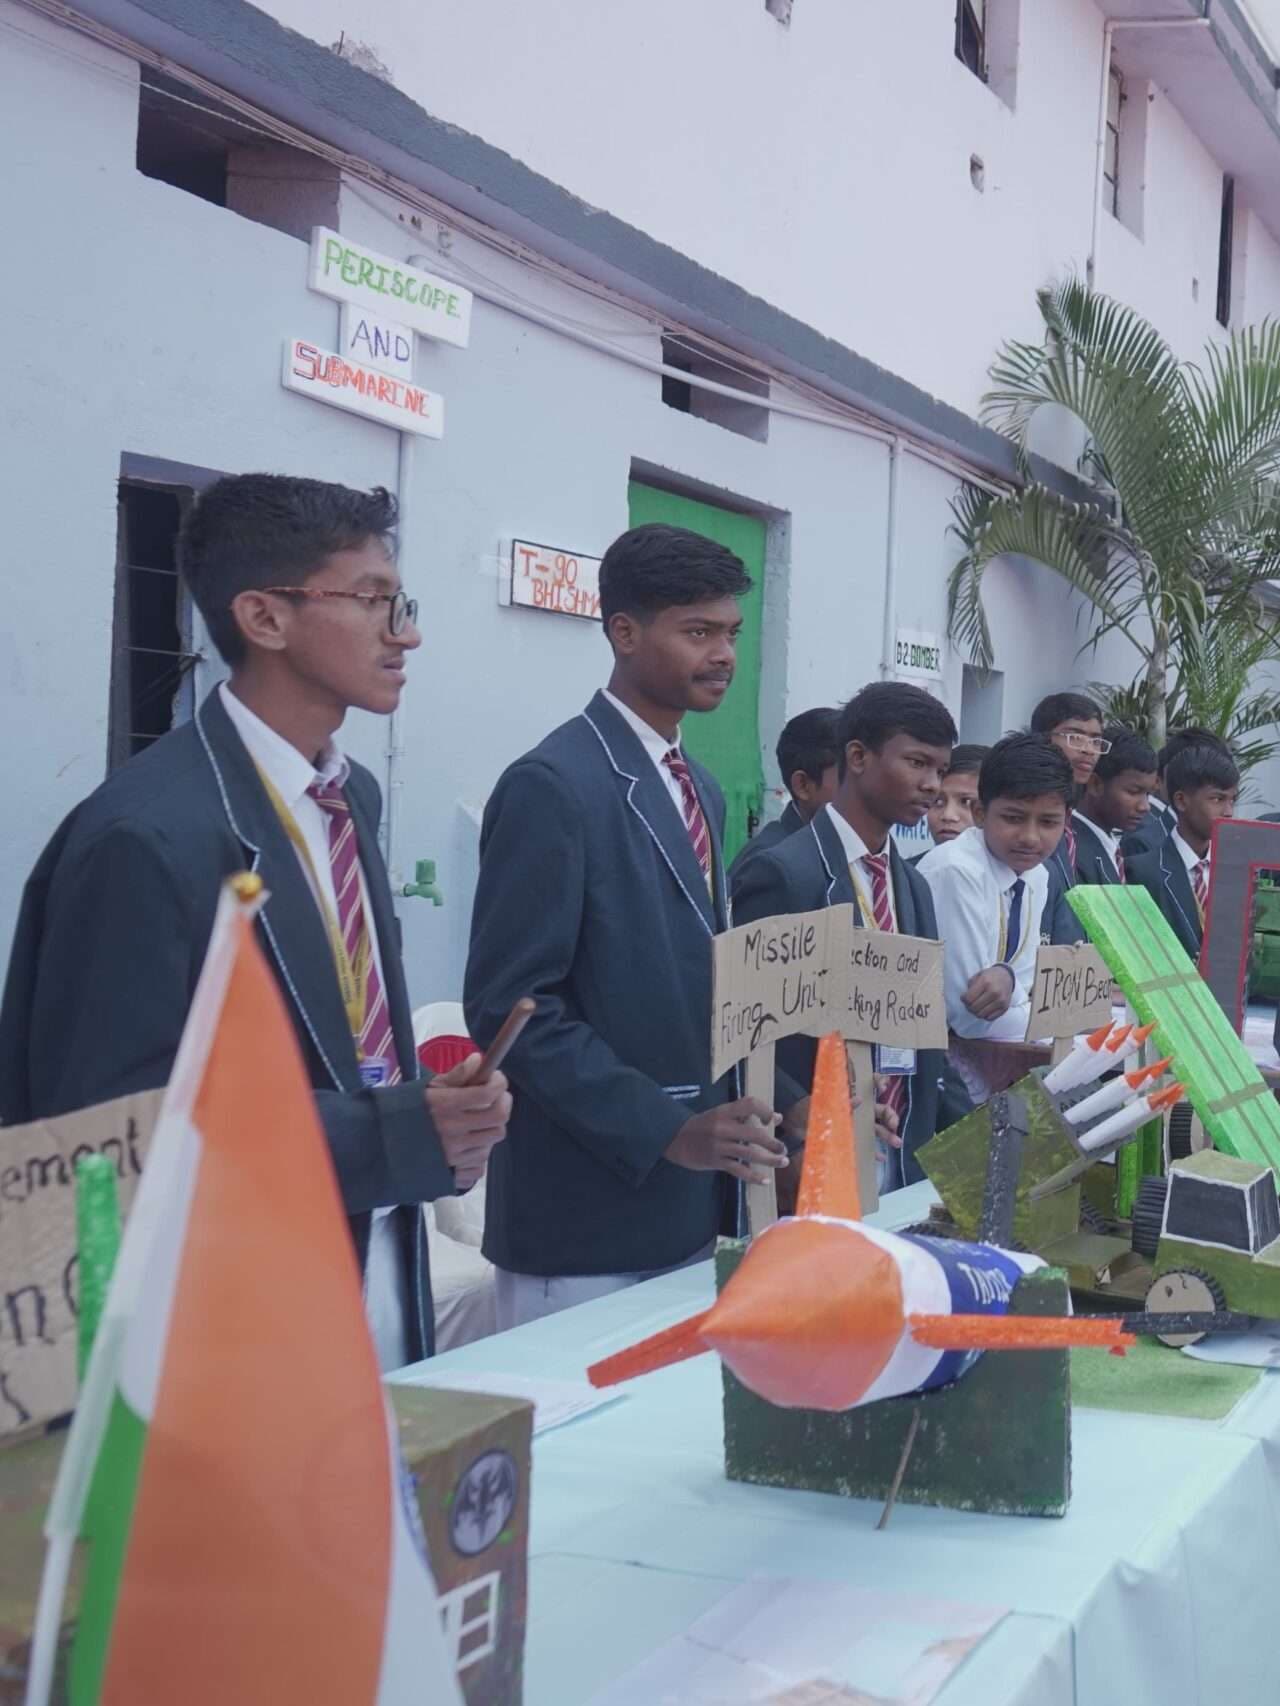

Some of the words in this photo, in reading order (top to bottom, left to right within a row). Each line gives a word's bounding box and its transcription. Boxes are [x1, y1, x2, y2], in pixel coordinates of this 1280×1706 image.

[324, 238, 461, 319] PERISCOPE
[351, 319, 411, 362] AND
[293, 341, 431, 419] SUBMARINE
[518, 546, 578, 586] T-90
[744, 921, 816, 970] Missile
[851, 942, 888, 971] ction
[896, 950, 920, 973] and
[848, 985, 881, 1031] king
[886, 990, 930, 1026] Radar
[1037, 967, 1083, 1014] IRON
[721, 1001, 778, 1052] Firing
